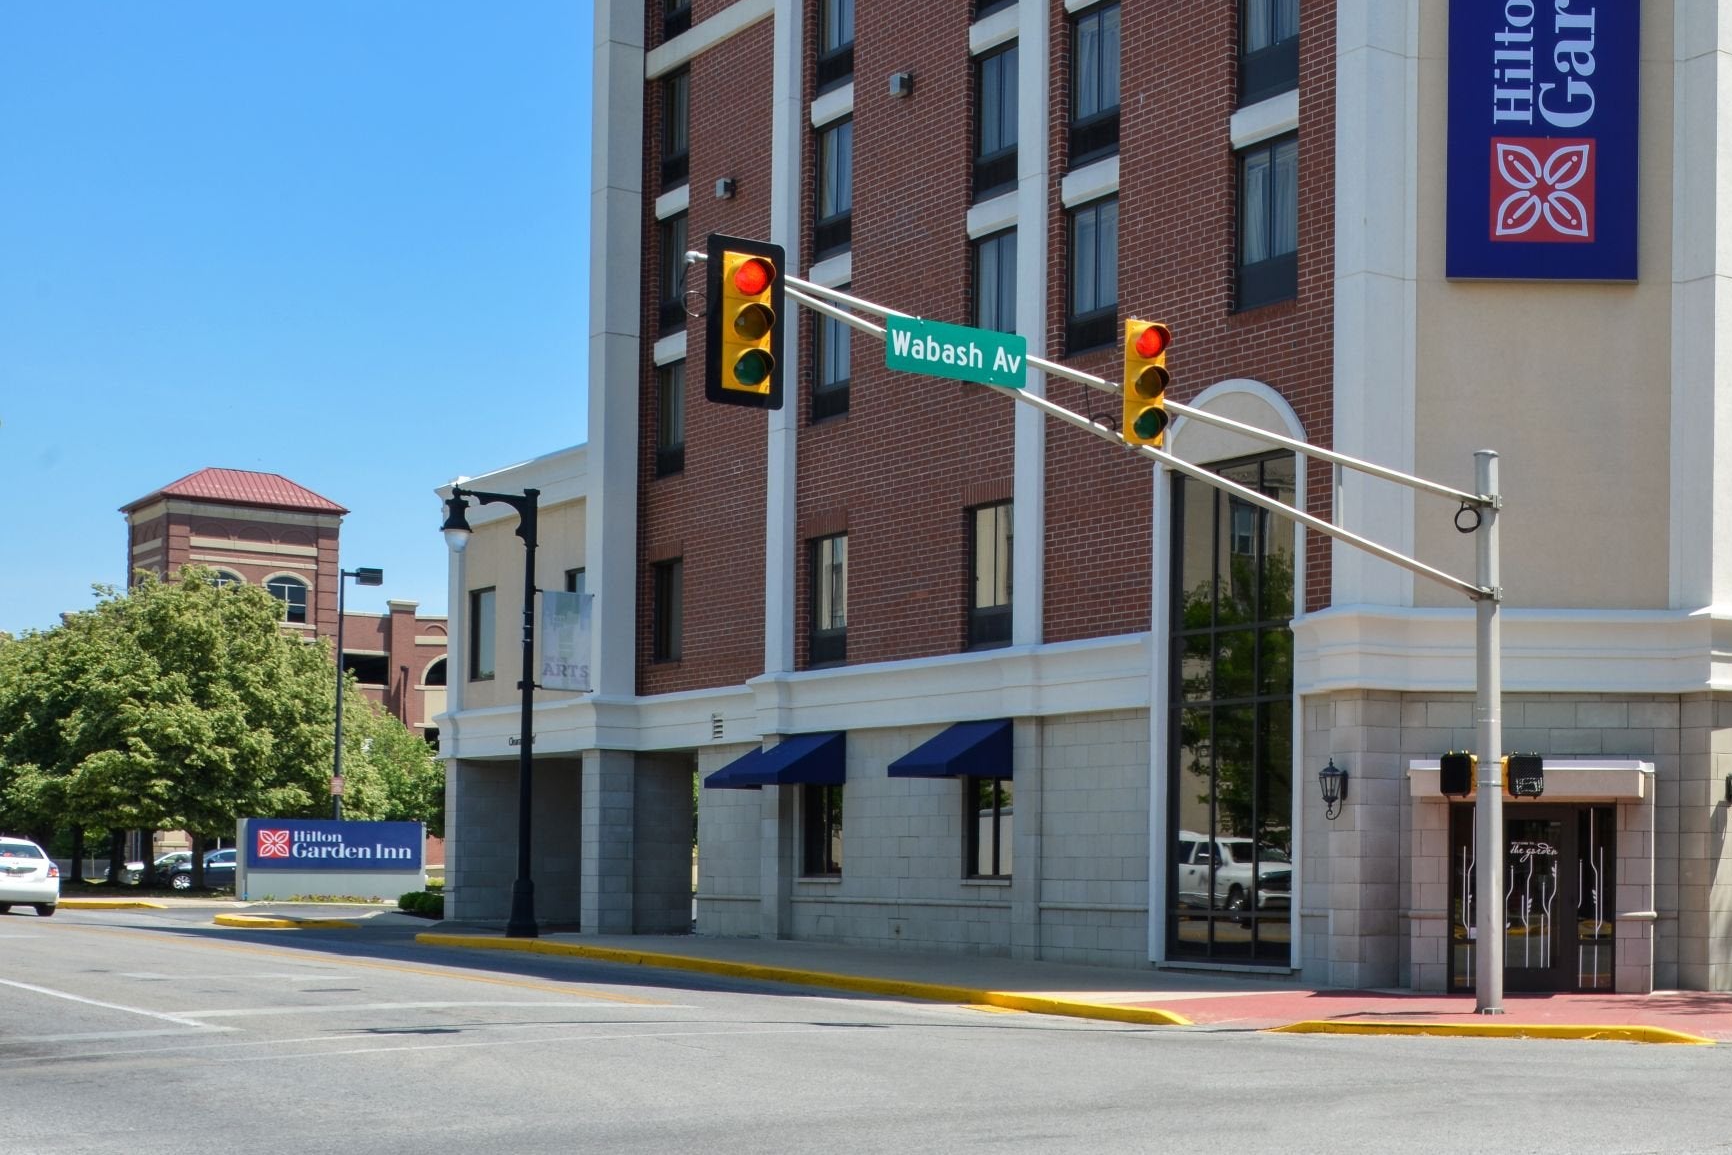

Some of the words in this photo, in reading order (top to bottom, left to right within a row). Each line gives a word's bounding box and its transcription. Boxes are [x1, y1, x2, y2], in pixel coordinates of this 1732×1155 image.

[892, 328, 983, 369] Wabash
[992, 346, 1022, 374] Av
[543, 663, 589, 678] ARTS
[294, 830, 342, 843] Hilton
[292, 842, 371, 859] Garden
[376, 843, 412, 860] Inn
